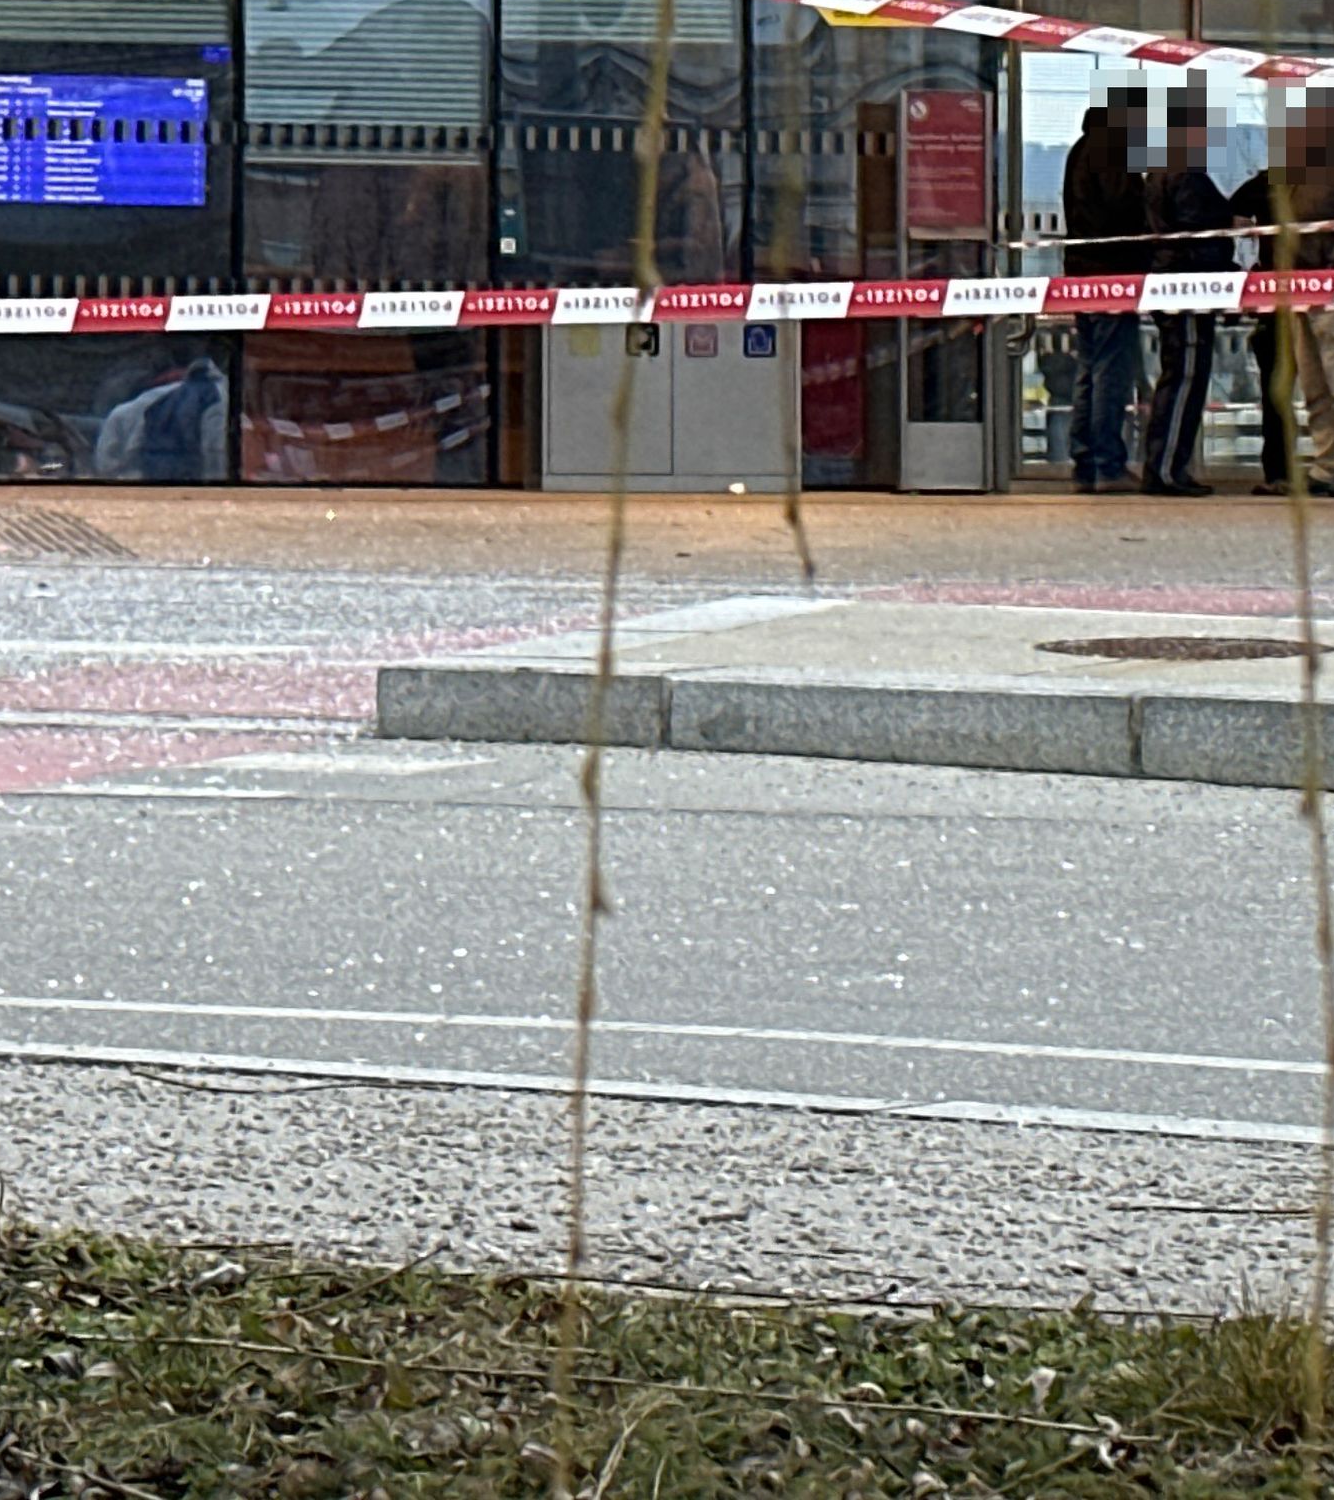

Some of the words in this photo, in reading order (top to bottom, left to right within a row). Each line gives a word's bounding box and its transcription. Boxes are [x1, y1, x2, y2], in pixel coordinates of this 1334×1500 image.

[867, 287, 940, 303] POLIZEI
[964, 286, 1037, 301] POLIZEI
[1063, 284, 1136, 300] POLIZEI
[1162, 282, 1234, 297] POLIZEI
[477, 298, 549, 314] POLIZEI
[575, 296, 635, 308] OLIZEI
[672, 291, 744, 307] POLIZEI
[92, 305, 164, 320] POLIZEI
[284, 301, 356, 318] POLIZEI
